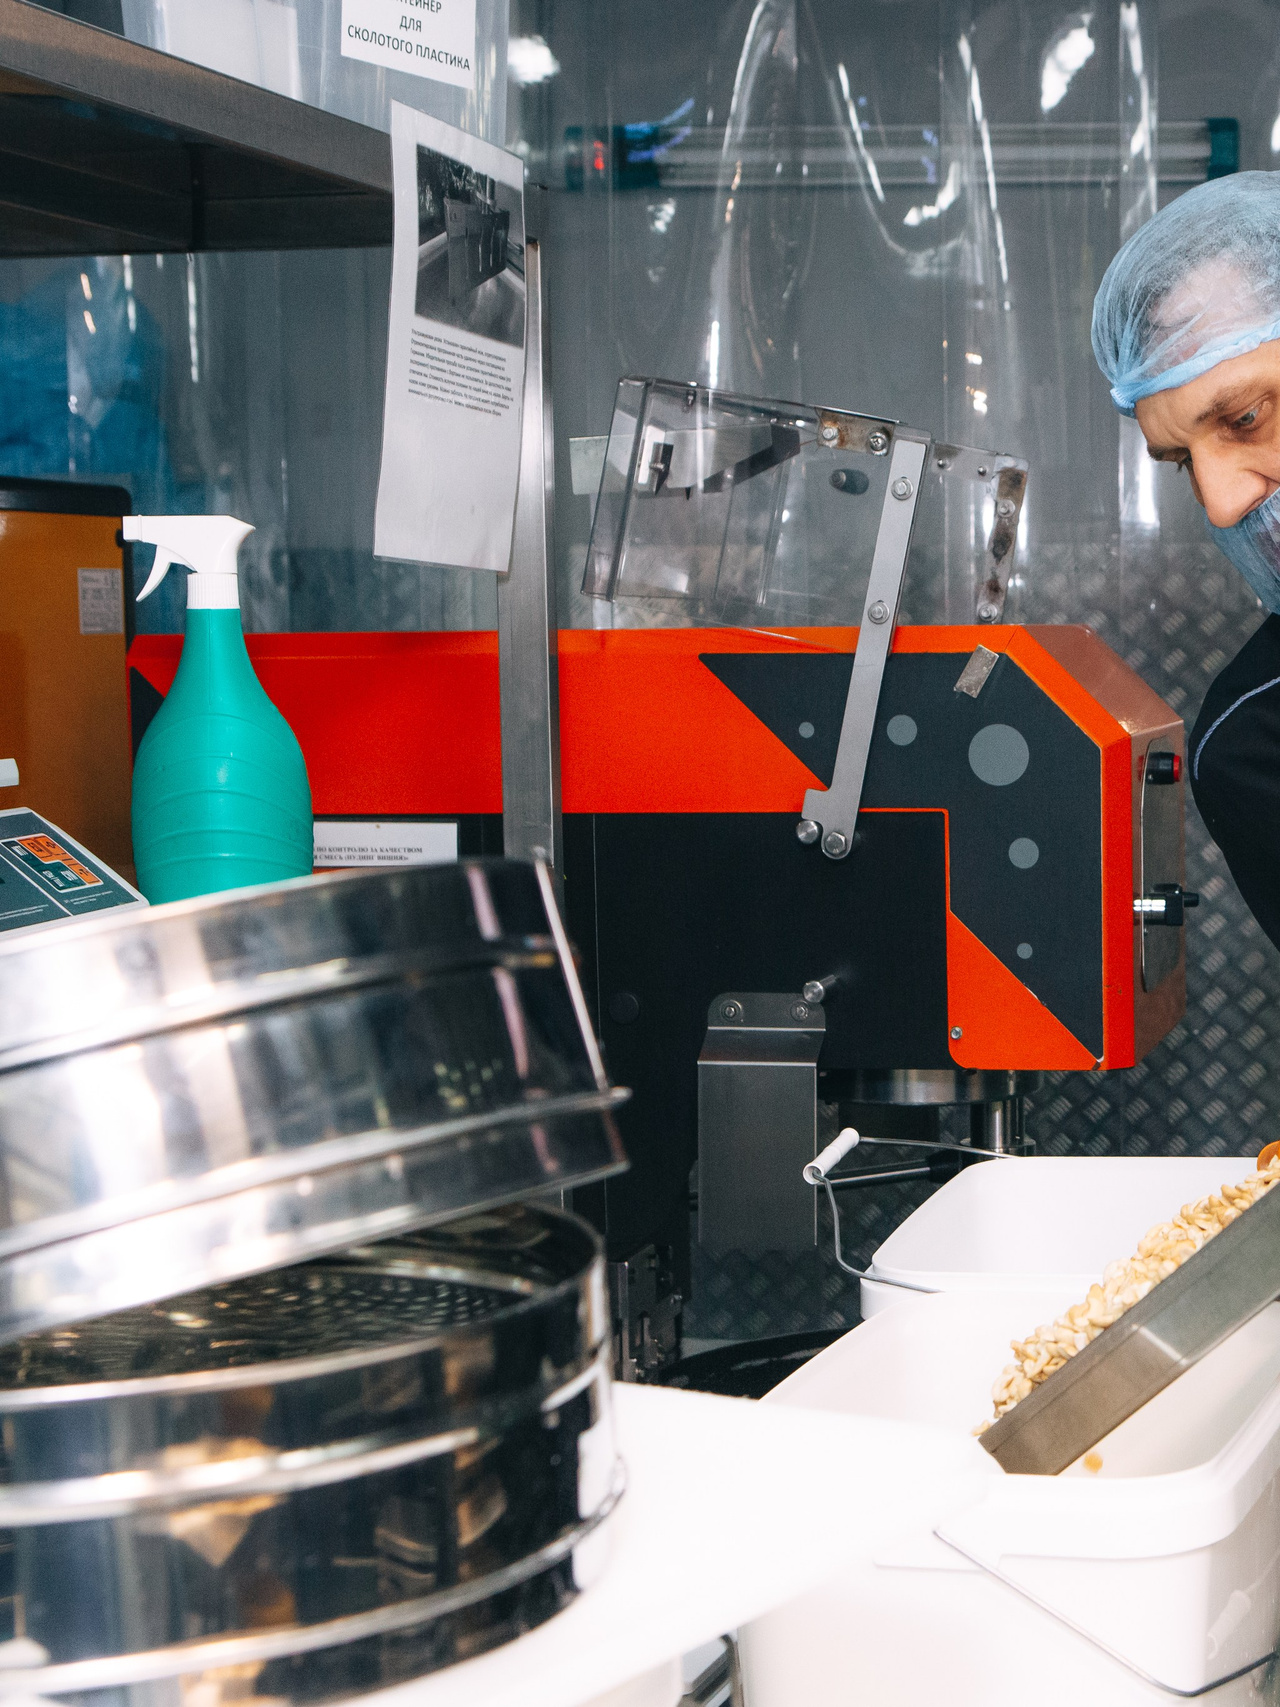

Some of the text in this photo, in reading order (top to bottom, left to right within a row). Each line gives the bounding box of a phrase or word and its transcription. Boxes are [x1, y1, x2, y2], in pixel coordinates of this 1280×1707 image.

[396, 0, 442, 13] ЕЙНЕР
[399, 15, 422, 32] ДЛЯ
[347, 24, 471, 71] СКОЛОТОГО ПЛАСТИКА
